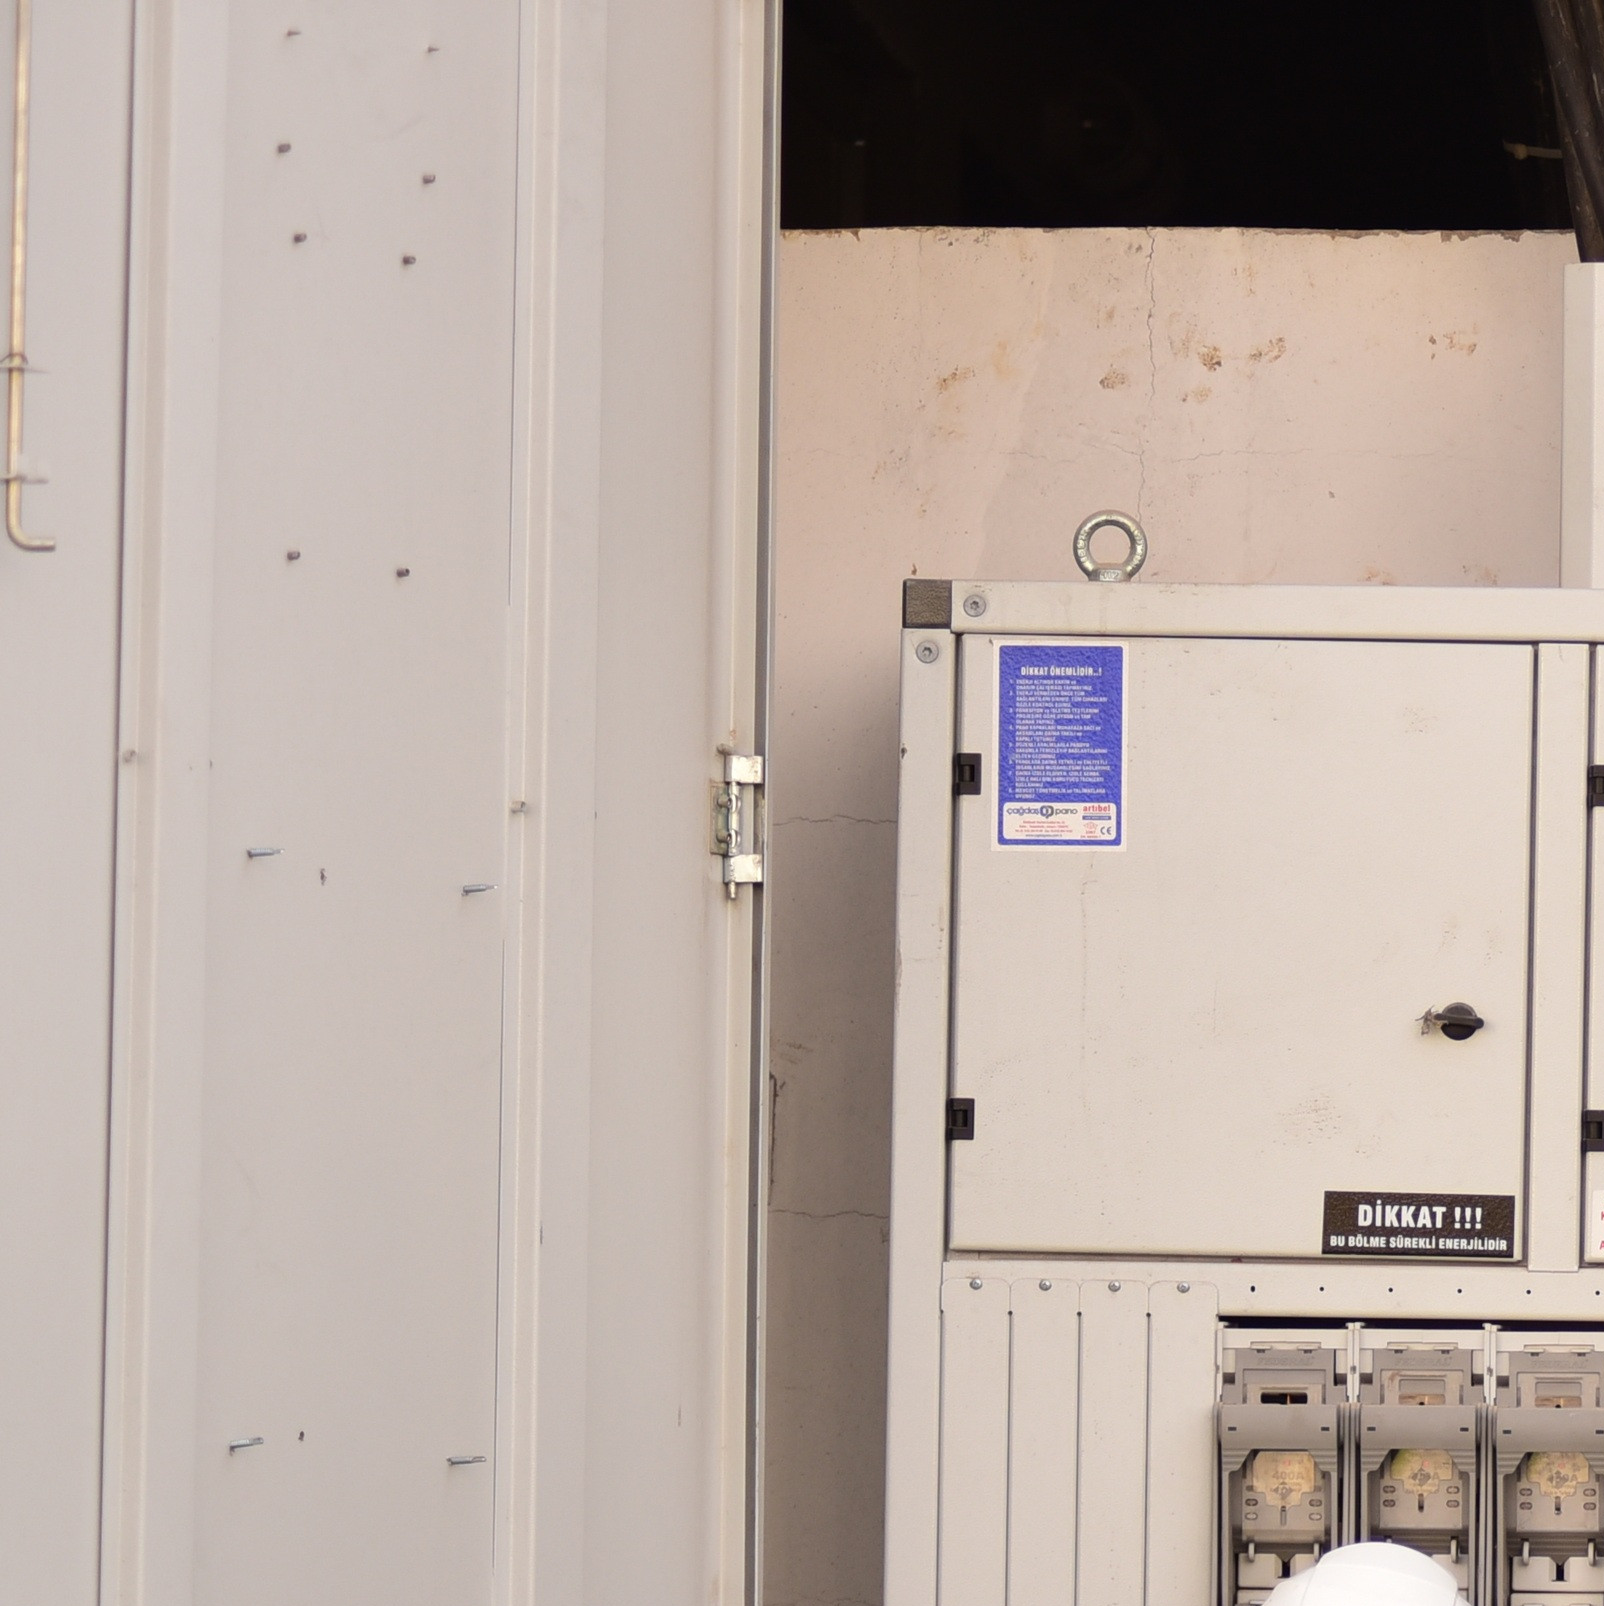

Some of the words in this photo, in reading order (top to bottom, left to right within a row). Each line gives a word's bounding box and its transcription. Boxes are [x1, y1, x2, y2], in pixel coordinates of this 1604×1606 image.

[1055, 808, 1078, 816] pano
[1357, 1199, 1448, 1229] DİKKAT
[1329, 1234, 1346, 1247] BU
[1347, 1233, 1387, 1248] BÖLME
[1389, 1234, 1436, 1250] SÜREKLİ
[1438, 1236, 1508, 1251] ENERJİLİDİR
